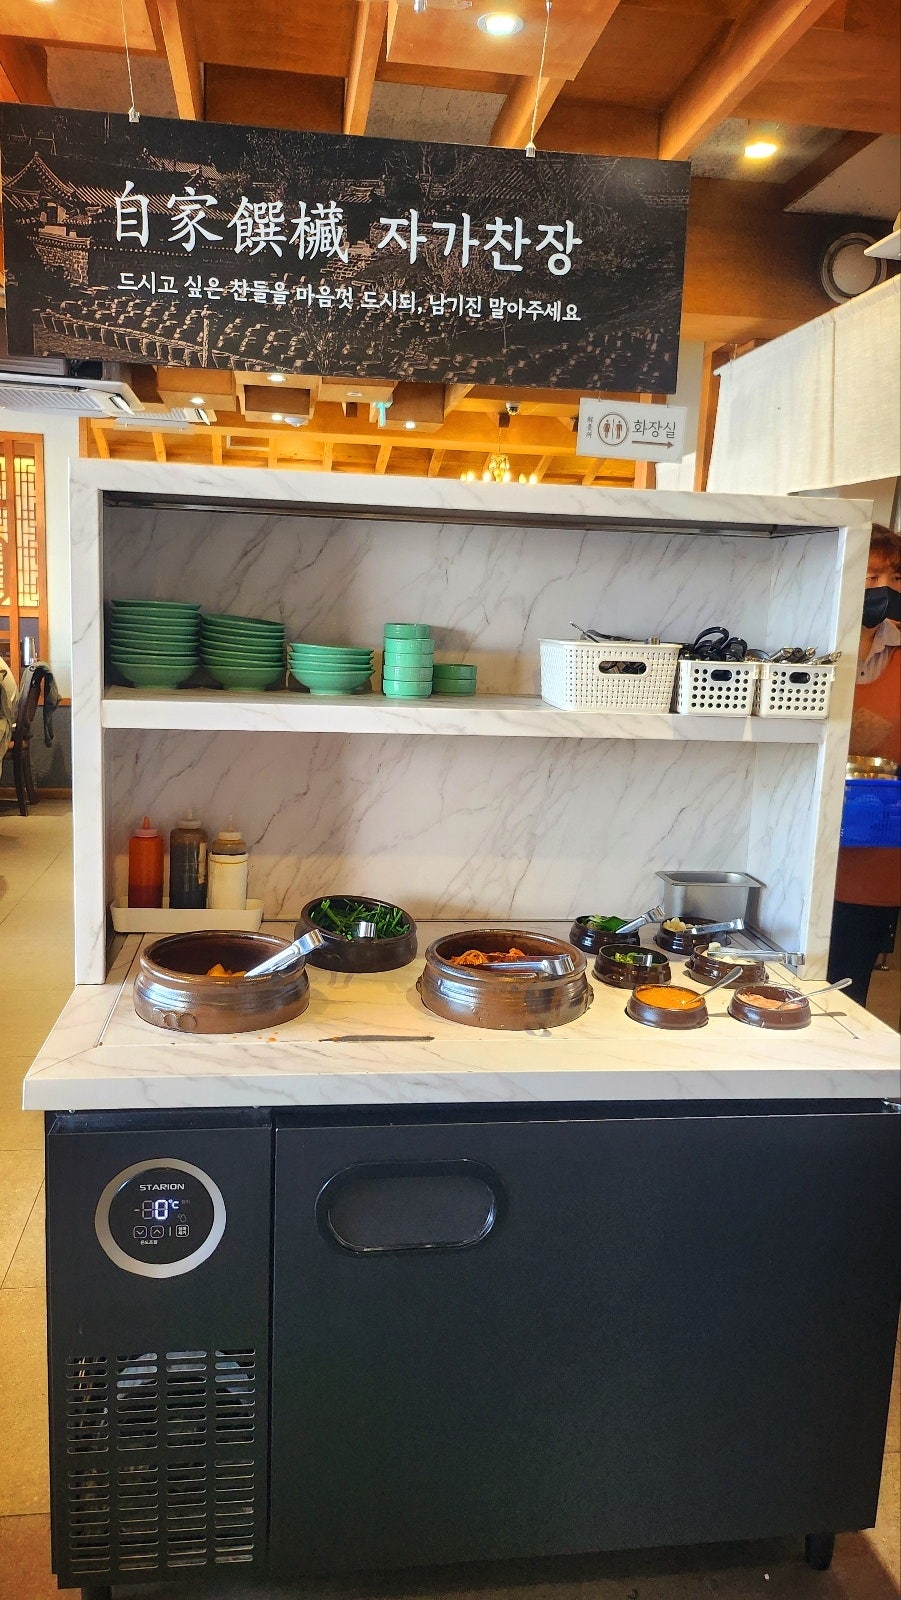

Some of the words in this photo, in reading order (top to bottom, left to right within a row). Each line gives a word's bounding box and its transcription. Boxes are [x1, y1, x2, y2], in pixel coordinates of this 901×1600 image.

[377, 208, 583, 276] 자가찬장
[117, 271, 179, 295] 드시고
[184, 274, 224, 300] 싶은
[229, 279, 290, 305] 찬들을
[296, 284, 354, 310] 마음껏
[429, 294, 482, 318] 남기진
[489, 297, 582, 323] 말아주세요
[632, 419, 676, 439] 화장실
[139, 1183, 185, 1191] STARION
